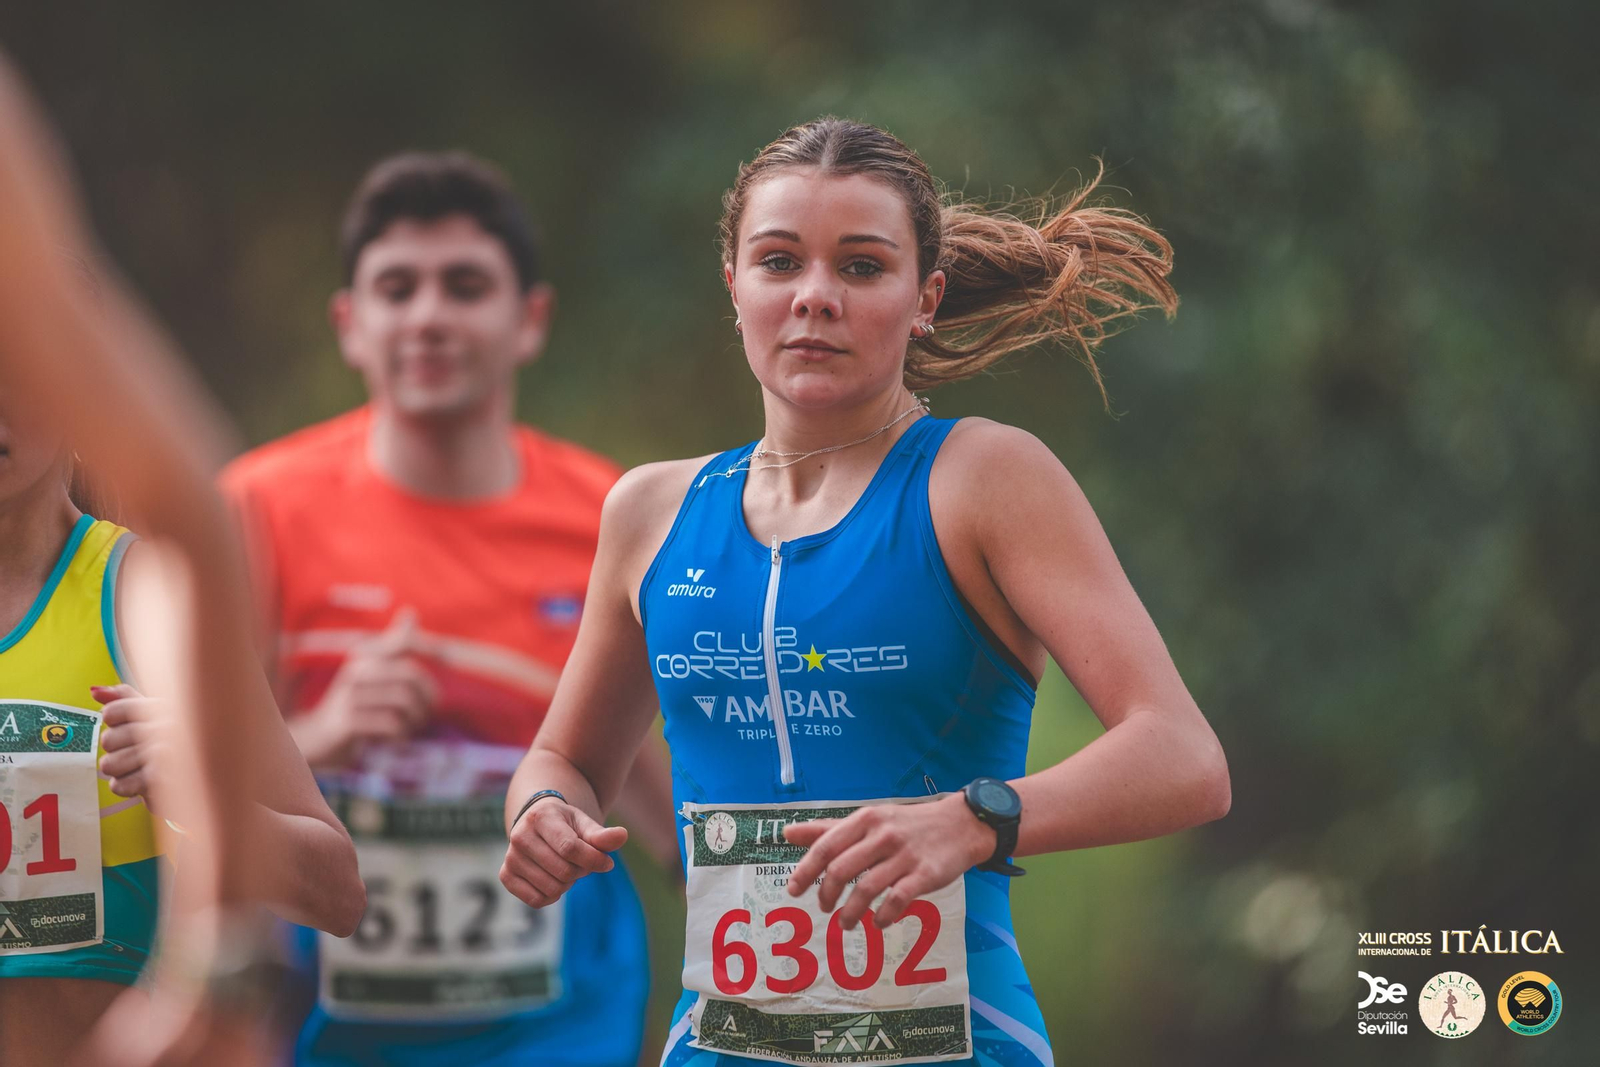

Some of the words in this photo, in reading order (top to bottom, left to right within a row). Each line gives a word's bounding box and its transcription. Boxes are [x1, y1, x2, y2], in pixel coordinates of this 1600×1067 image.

[667, 583, 716, 599] amura
[693, 626, 798, 653] CLUB
[724, 690, 856, 723] AMBAR
[738, 723, 800, 740] TRIPLE
[803, 724, 843, 737] ZERO
[0, 793, 76, 876] 1
[756, 865, 797, 876] DERBA
[40, 913, 86, 925] docunova
[712, 899, 947, 995] 6302
[911, 1023, 955, 1037] docunova
[746, 1047, 792, 1061] FEDERACIÓN
[795, 1053, 838, 1063] ANDALUZA
[856, 1053, 902, 1063] ATLETISMO
